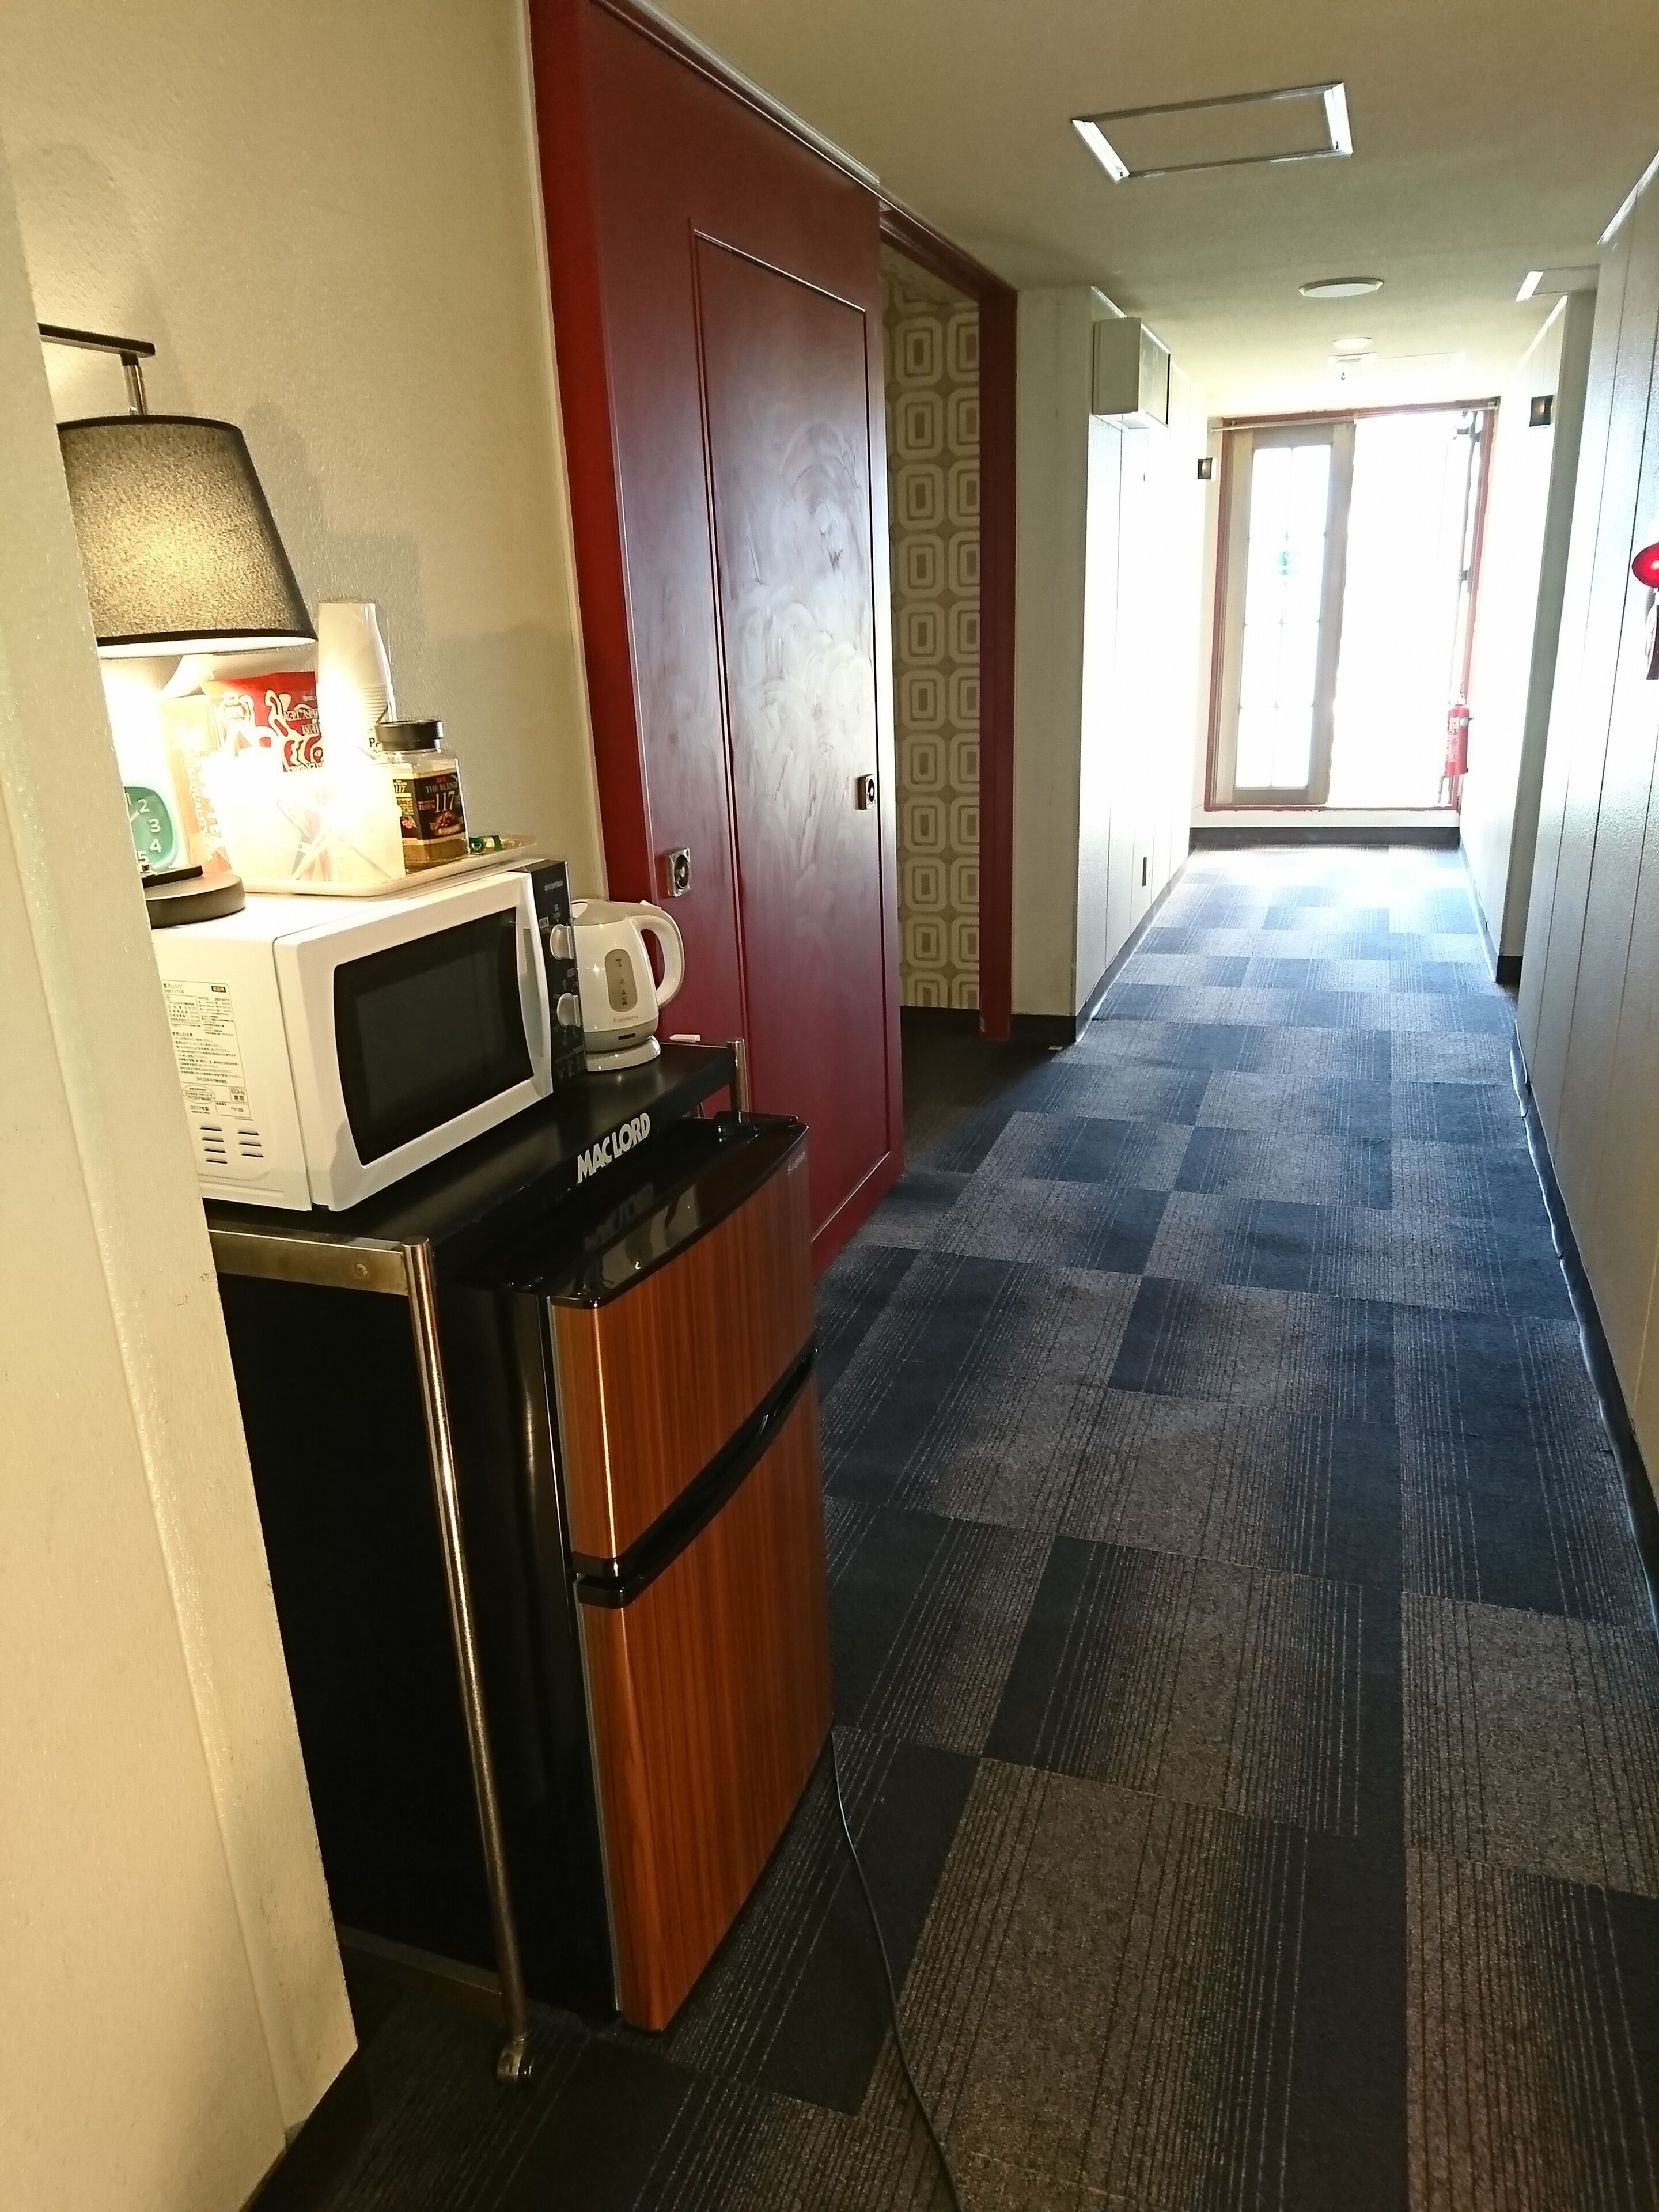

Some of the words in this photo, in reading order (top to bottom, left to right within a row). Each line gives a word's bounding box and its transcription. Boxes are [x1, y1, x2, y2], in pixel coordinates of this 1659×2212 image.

[425, 785, 438, 793] THE
[439, 781, 458, 791] BLEND
[137, 798, 150, 813] 2
[434, 790, 455, 813] 117
[147, 818, 161, 833] 3
[149, 838, 162, 853] 4
[138, 850, 150, 863] 5
